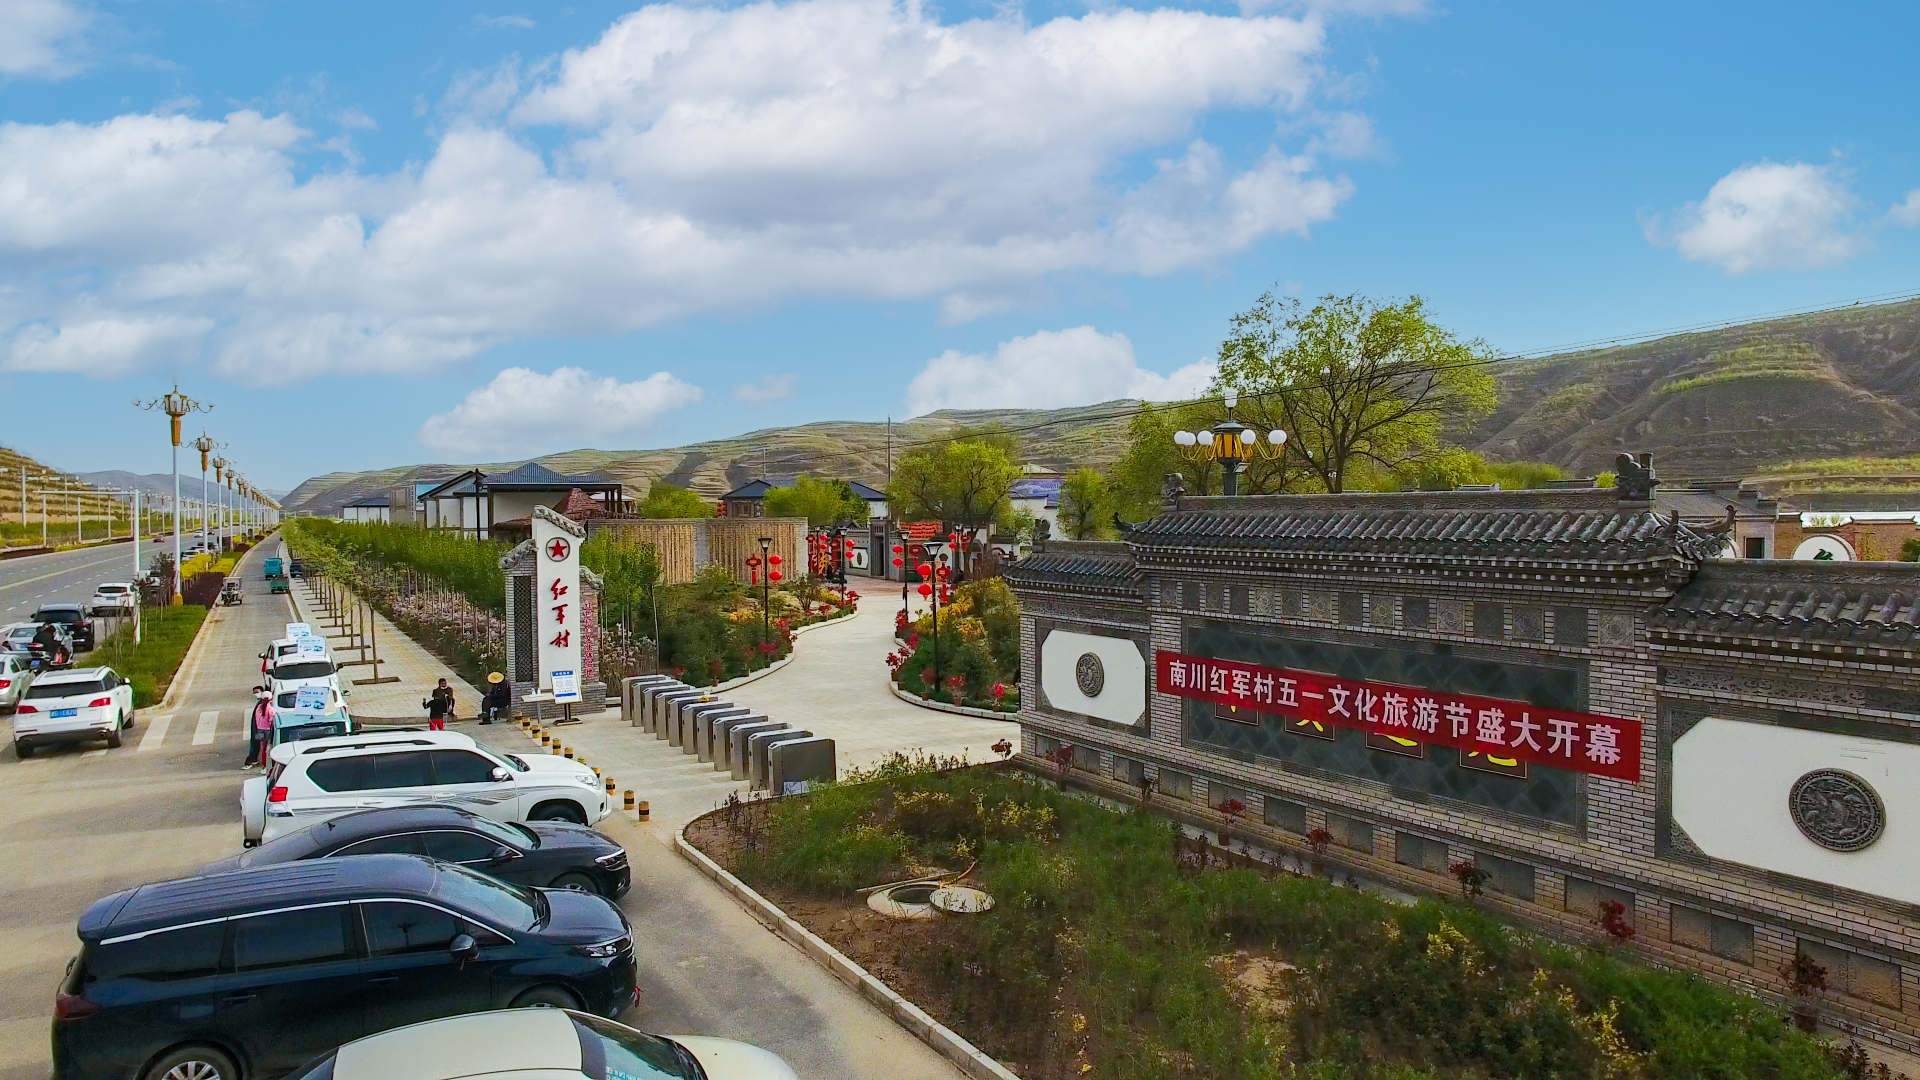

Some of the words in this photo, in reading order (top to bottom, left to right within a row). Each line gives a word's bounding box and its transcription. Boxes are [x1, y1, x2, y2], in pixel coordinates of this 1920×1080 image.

[550, 577, 571, 648] 红军村
[1166, 659, 1621, 765] 南川红军村五一文化旅游节盛大开幕
